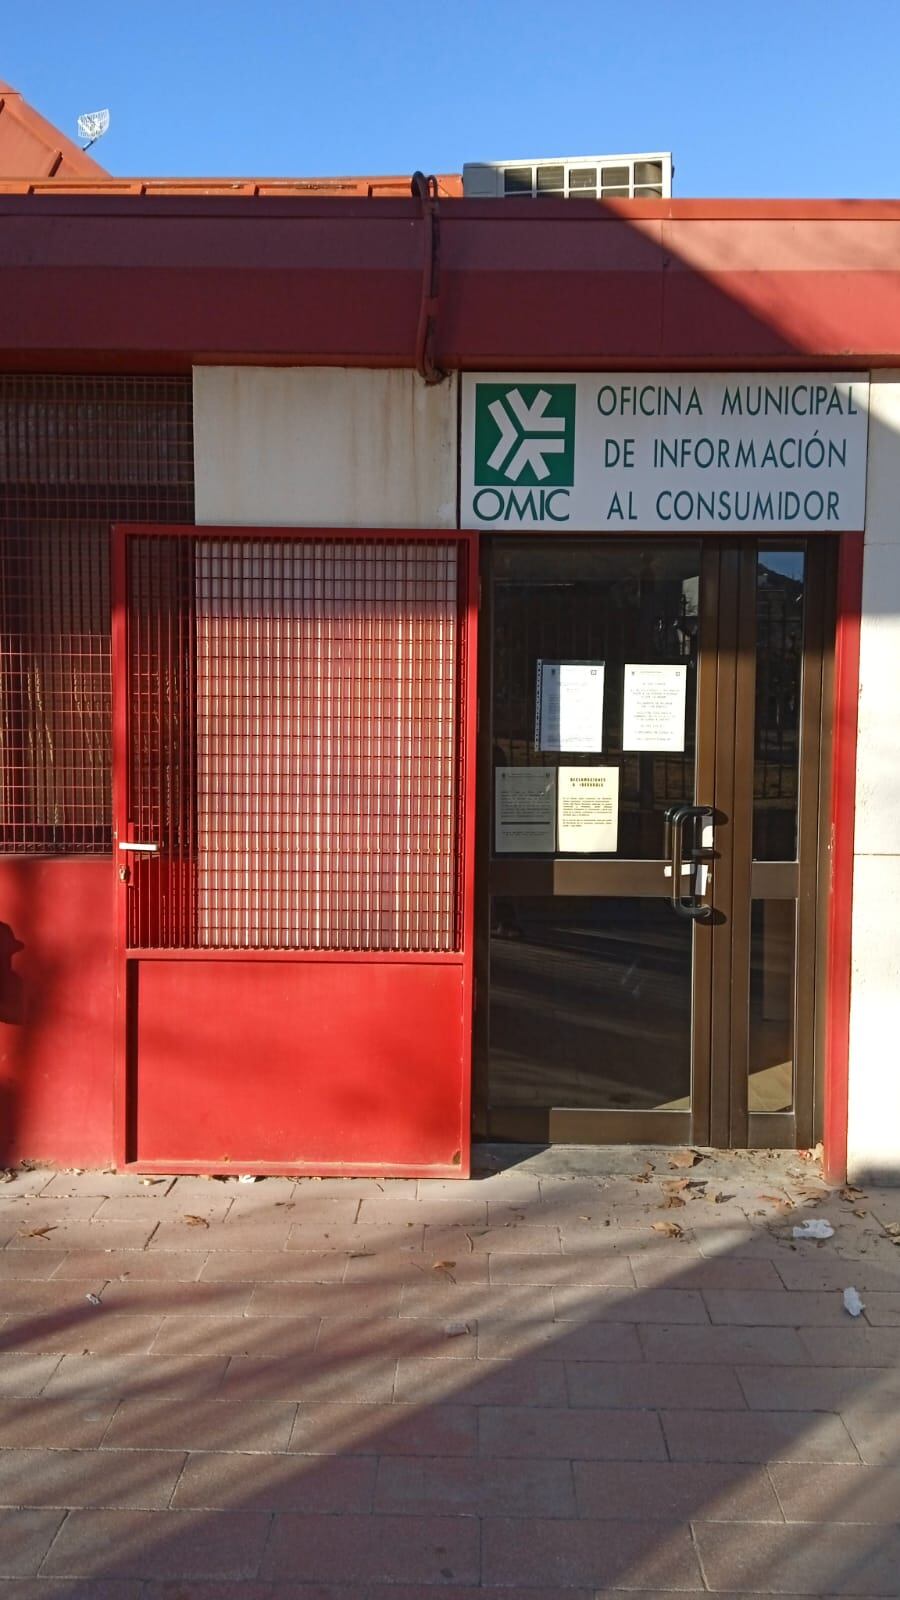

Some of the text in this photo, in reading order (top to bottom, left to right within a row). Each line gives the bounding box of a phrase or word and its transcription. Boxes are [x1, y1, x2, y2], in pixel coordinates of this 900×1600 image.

[597, 385, 858, 416] OFICINA MUNICIPAL
[605, 430, 846, 468] DE INFORMACIÓN
[473, 488, 570, 521] OMIC
[607, 490, 840, 521] AL CONSUMIDOR
